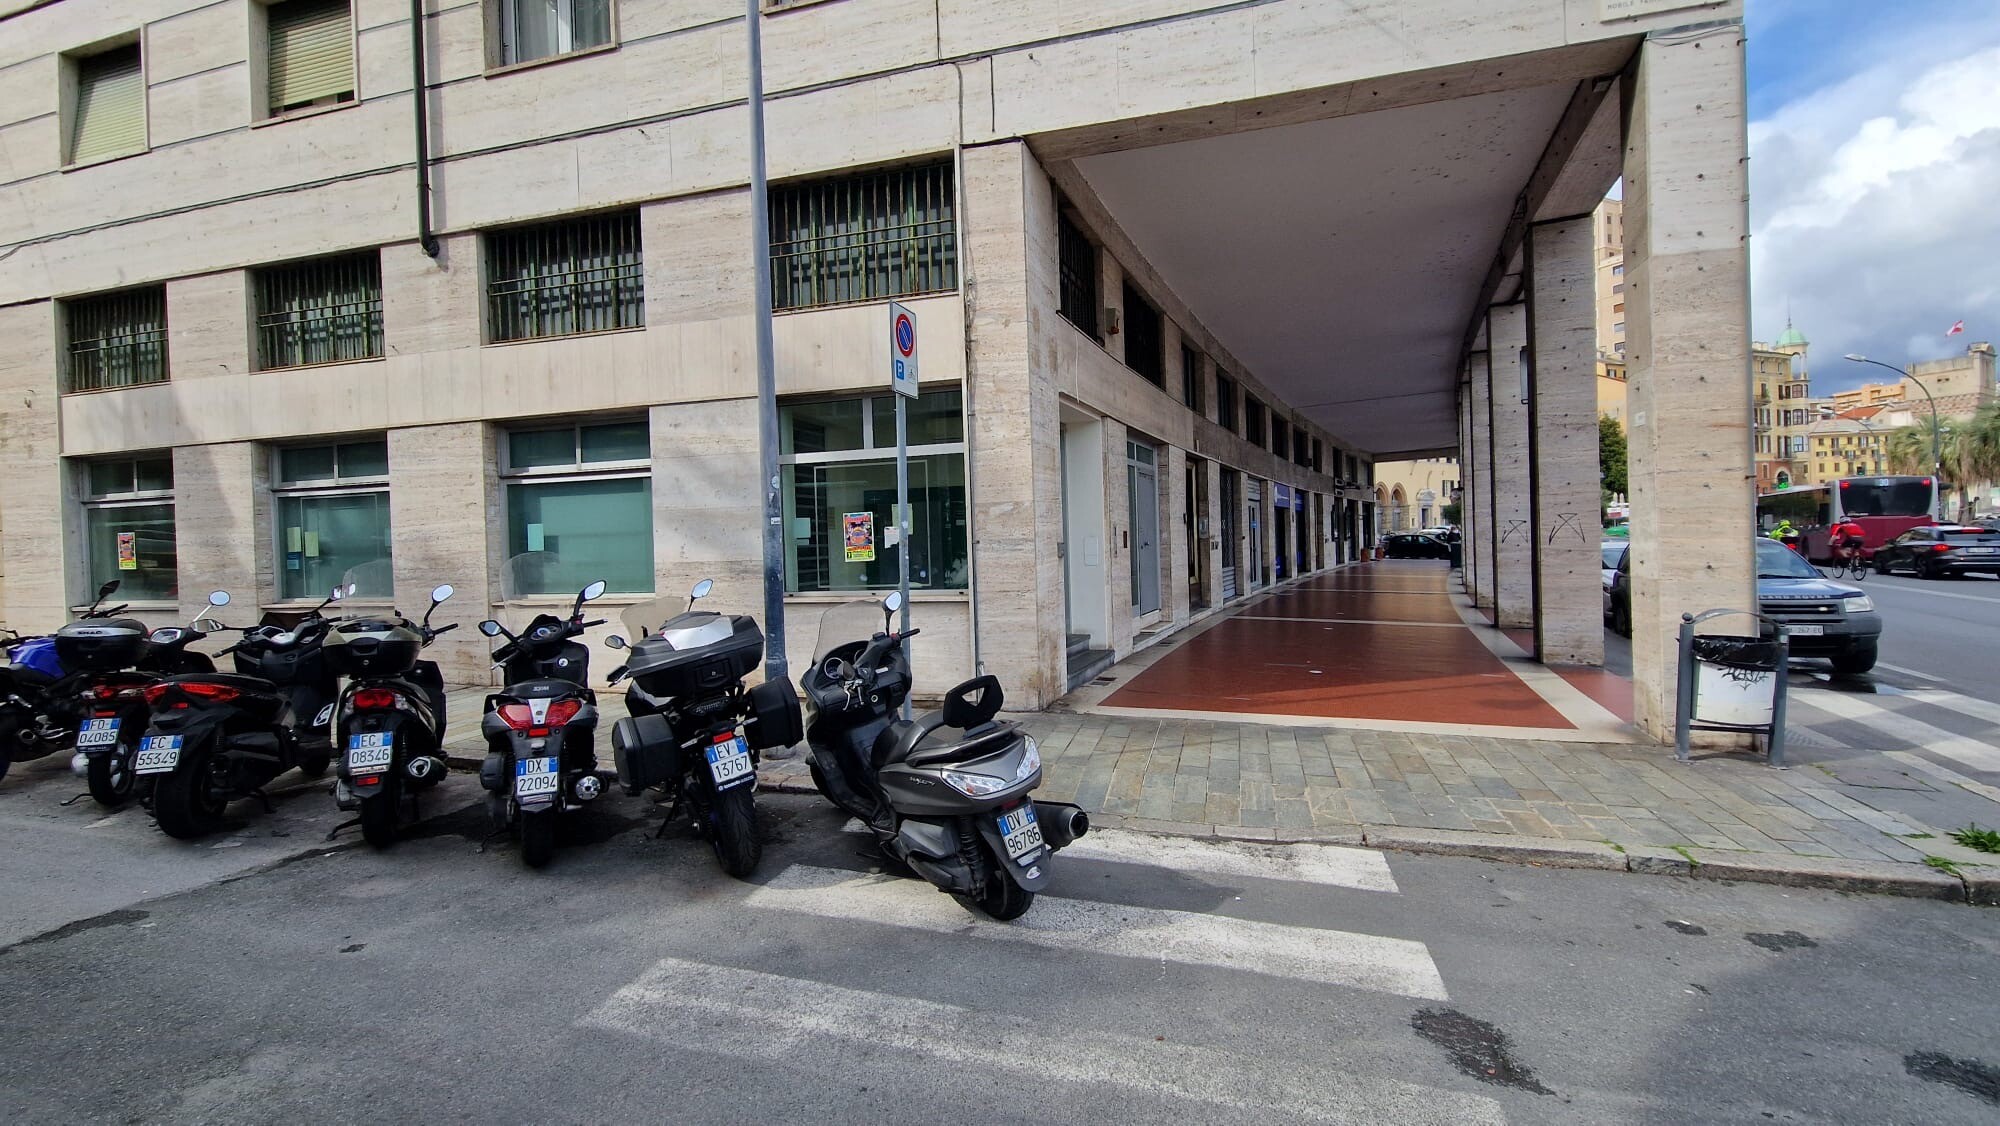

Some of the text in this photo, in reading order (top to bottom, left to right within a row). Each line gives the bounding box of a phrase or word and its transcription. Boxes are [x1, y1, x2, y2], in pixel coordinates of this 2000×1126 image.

[897, 363, 903, 377] P
[90, 719, 106, 730] FD
[79, 731, 116, 744] 04085
[149, 736, 167, 749] EC
[361, 734, 377, 747] EG
[137, 751, 177, 766] 55349
[351, 748, 390, 764] 08346
[716, 743, 731, 759] EV
[527, 759, 542, 774] DX
[715, 755, 748, 779] 13767
[519, 775, 557, 792] 22094
[1006, 811, 1021, 831] DV
[1007, 826, 1041, 854] 96786
